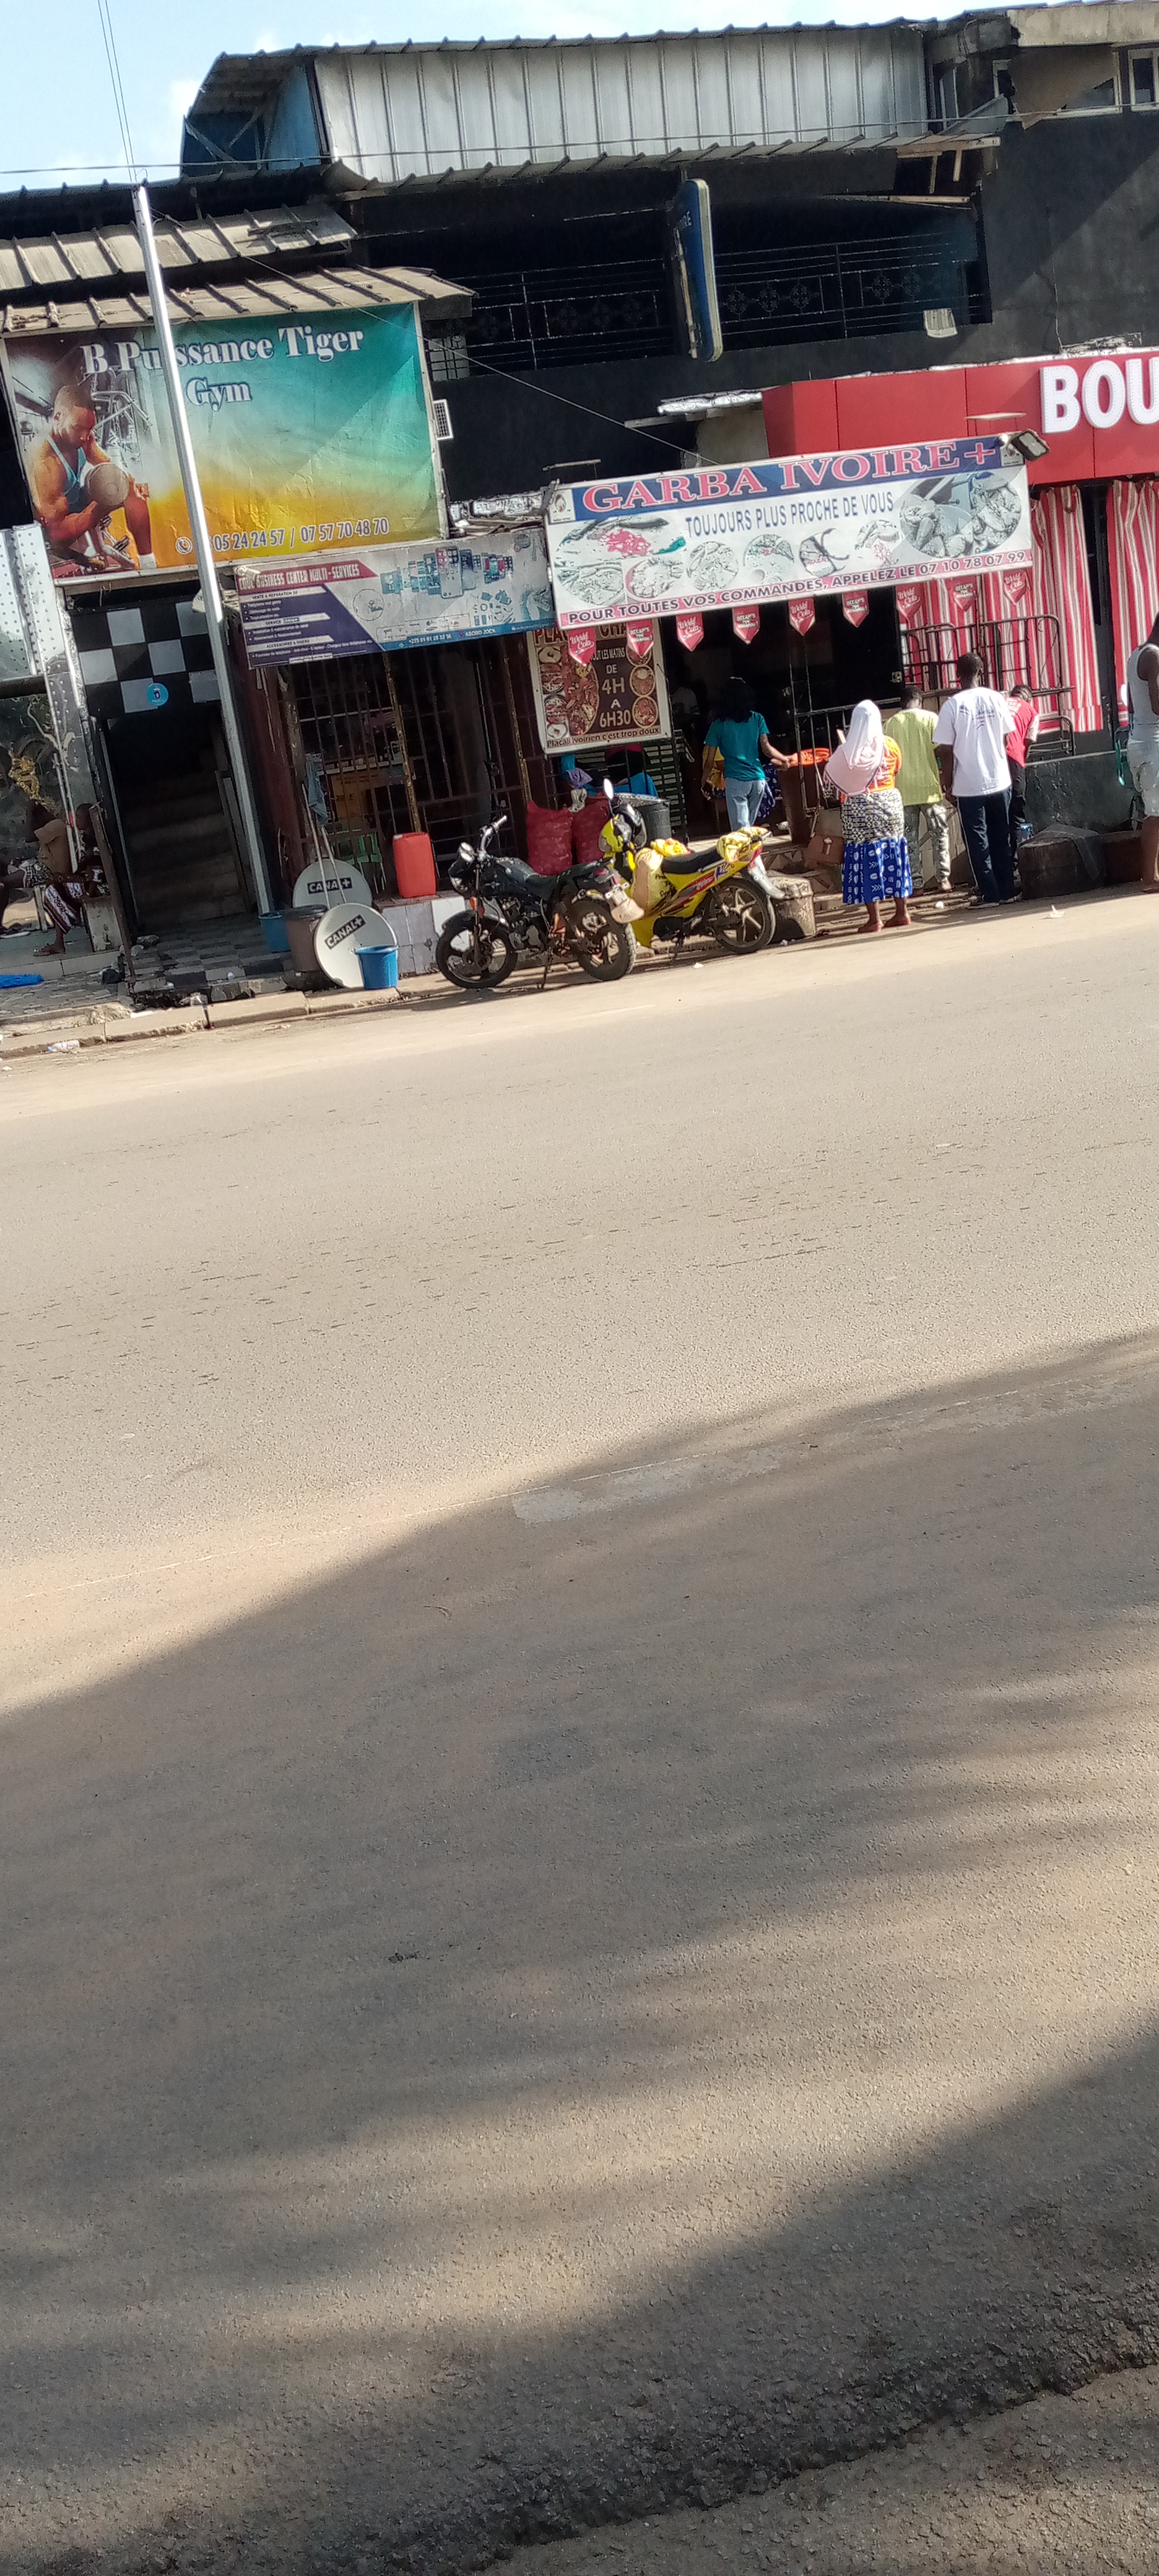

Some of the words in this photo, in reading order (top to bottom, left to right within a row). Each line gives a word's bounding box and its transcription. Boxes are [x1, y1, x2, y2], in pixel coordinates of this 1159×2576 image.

[114, 336, 273, 372] Pussance
[277, 326, 364, 362] Tiger
[186, 377, 252, 411] Gym
[1040, 356, 1159, 433] BOU
[583, 467, 767, 512] GARBA
[779, 442, 960, 490] IVOIRE
[685, 508, 752, 537] TOUJOURS
[756, 505, 787, 529] PLUS
[791, 497, 839, 524] PROCHE
[843, 495, 858, 516] DE
[861, 492, 893, 515] VOUS
[214, 534, 230, 551] 05
[233, 533, 248, 549] 24
[251, 531, 267, 547] 24
[269, 529, 285, 546] 57
[300, 526, 316, 542] 07
[319, 523, 335, 541] 57
[337, 522, 352, 539] 70
[355, 520, 371, 537] 48
[373, 518, 389, 535] 70
[256, 572, 285, 588] BUSINESS
[286, 570, 308, 585] CENTER
[1004, 572, 1022, 586] World
[1010, 580, 1025, 591] Cola
[568, 609, 614, 624] POUR
[619, 599, 679, 616] TOUTES
[684, 592, 716, 607] VOS
[720, 580, 828, 603] COMMANDES,
[831, 568, 896, 588] APPELEZ
[899, 565, 915, 578] LE
[920, 562, 938, 575] 07
[942, 559, 959, 572] 10
[965, 557, 983, 569] 78
[986, 554, 1003, 566] 07
[1007, 550, 1025, 563] 99
[897, 586, 915, 601] World
[904, 596, 921, 606] Cola
[790, 601, 807, 616] World
[797, 608, 814, 620] Cola
[679, 616, 696, 630] World
[685, 625, 701, 636] Cola
[570, 632, 589, 645] World
[578, 640, 594, 650] Cola
[591, 650, 601, 661] OUT
[606, 664, 618, 674] DE
[602, 677, 625, 694] 4H
[610, 698, 621, 708] A
[599, 709, 631, 728] 6H30
[602, 733, 619, 741] c'est
[621, 731, 638, 739] trop
[639, 727, 659, 736] doux
[310, 878, 350, 892] CANA+
[327, 918, 362, 947] CANAL+
